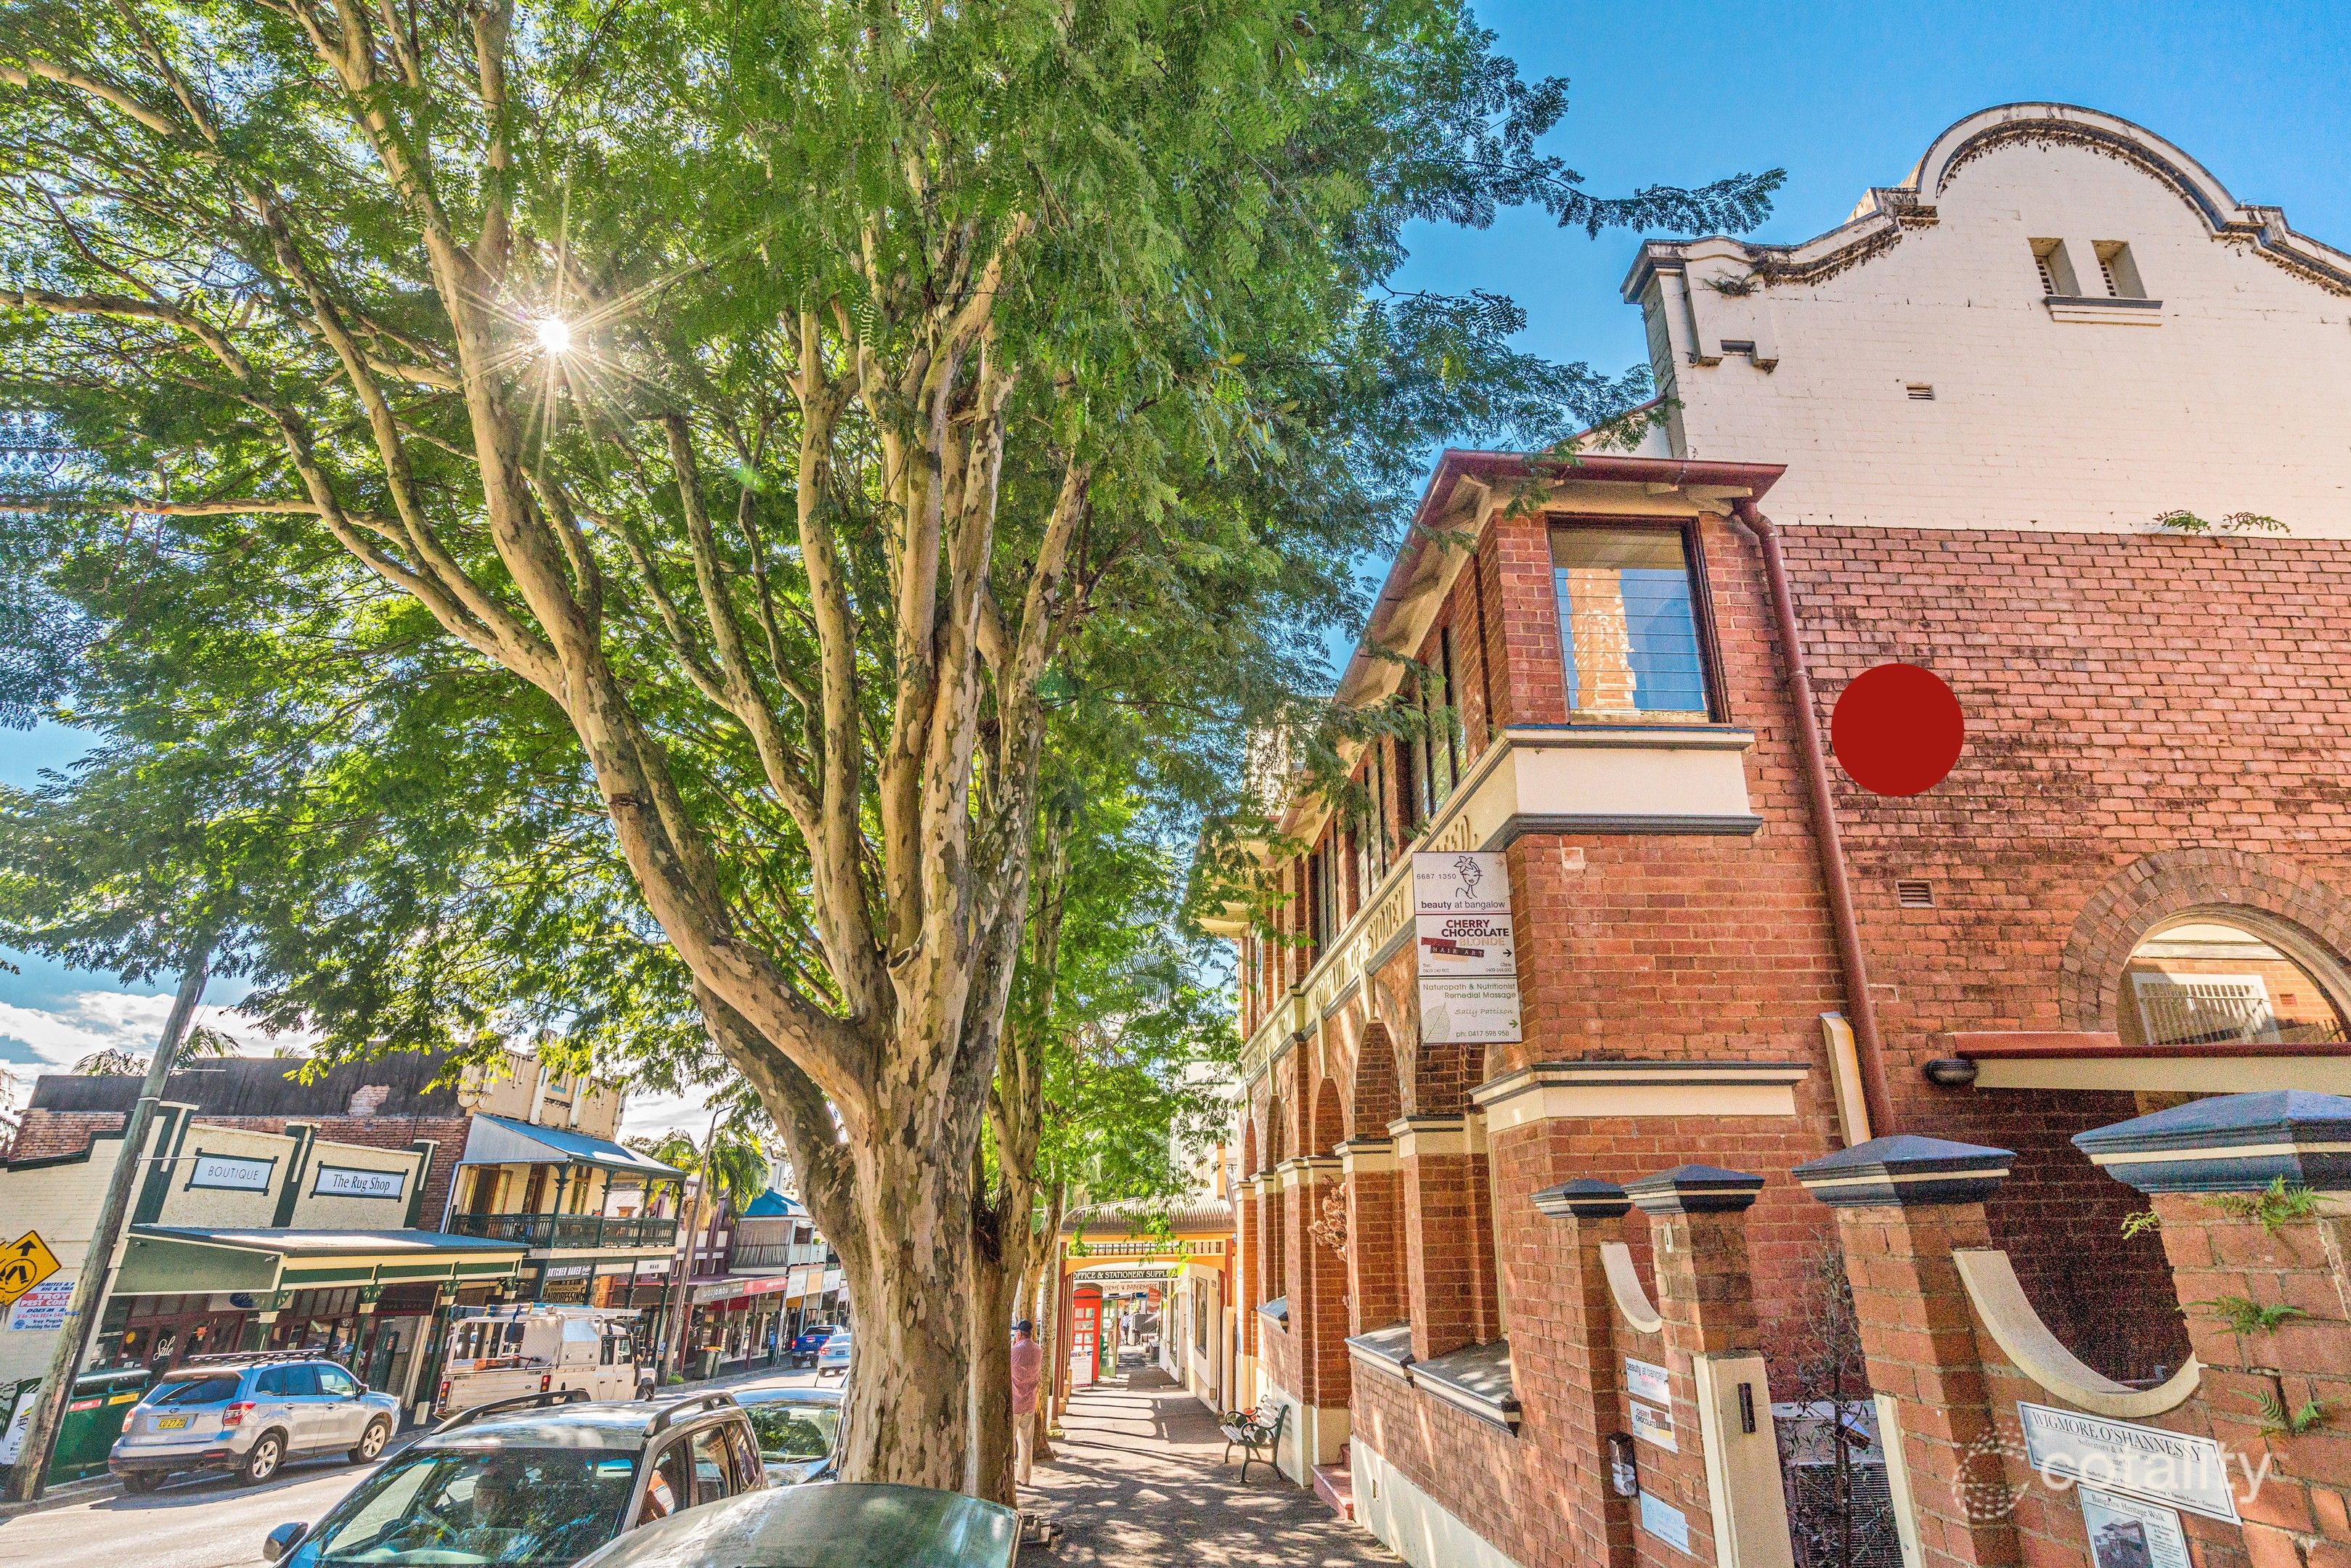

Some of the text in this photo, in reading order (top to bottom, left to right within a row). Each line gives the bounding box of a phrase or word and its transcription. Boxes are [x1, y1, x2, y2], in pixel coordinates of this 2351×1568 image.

[1421, 901, 1451, 910] beauty
[1464, 901, 1505, 910] bangalow
[1368, 886, 1405, 956] SYDNEY
[1446, 919, 1490, 928] CHERRY
[1441, 928, 1509, 937] CHOCOLATE
[1459, 937, 1505, 946] BLONDE
[1454, 1008, 1478, 1017] Sally
[208, 1166, 259, 1180] BOUTIQUE
[333, 1174, 391, 1193] The Rug Shop
[547, 1267, 567, 1277] BUTCHER
[542, 1287, 584, 1303] HAIRDRESSING
[153, 1336, 176, 1360] Sale
[1636, 1408, 1650, 1418] CHERRY
[1635, 1415, 1657, 1429] CHOCOLATE
[2032, 1410, 2201, 1462] WIGMORE O'SHANNESSY
[2077, 1438, 2110, 1453] Solicitors
[2122, 1502, 2147, 1518] Heritage
[2148, 1509, 2165, 1522] Walk
